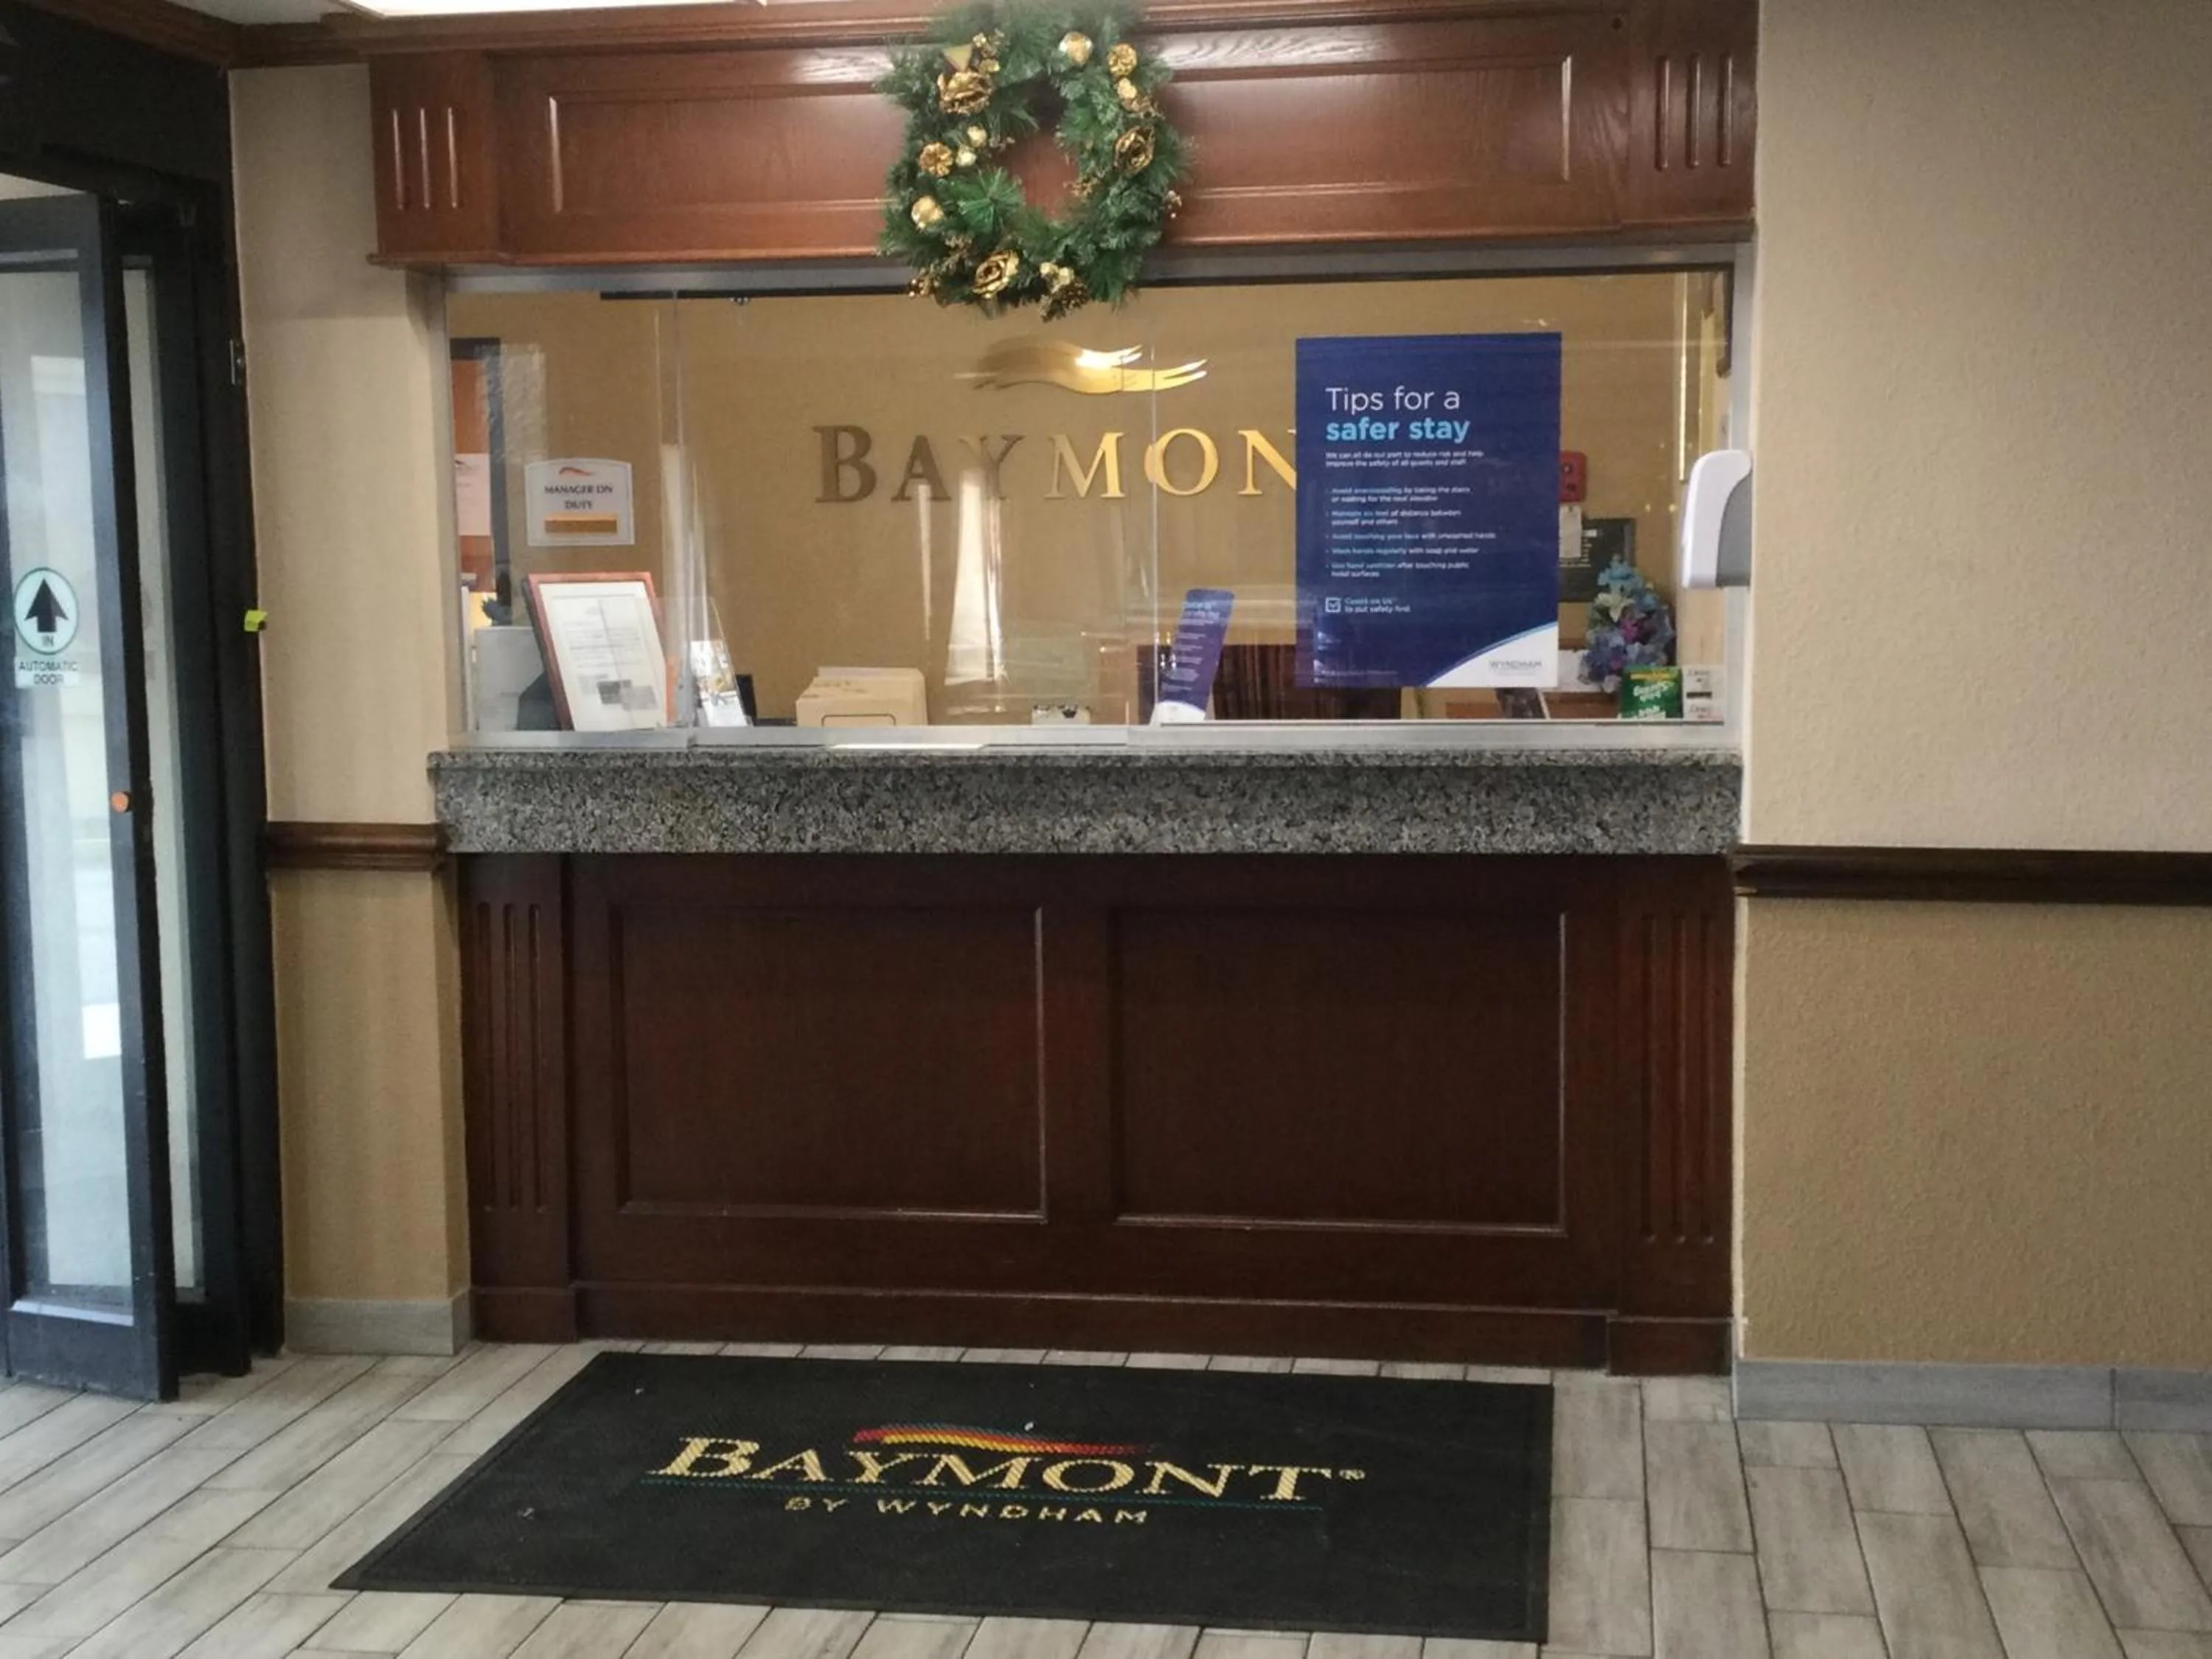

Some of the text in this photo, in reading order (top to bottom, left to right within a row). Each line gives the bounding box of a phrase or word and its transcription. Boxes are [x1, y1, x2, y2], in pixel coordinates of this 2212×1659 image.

[1326, 386, 1461, 414] Tips for a
[1326, 417, 1471, 444] safer stay
[544, 483, 613, 494] MANAGER ON
[565, 499, 593, 509] DUTY
[41, 635, 55, 647] IN
[19, 661, 78, 672] AUTOMATIC
[34, 673, 64, 685] DOOR
[785, 1496, 1148, 1524] BY WYNDHAM
